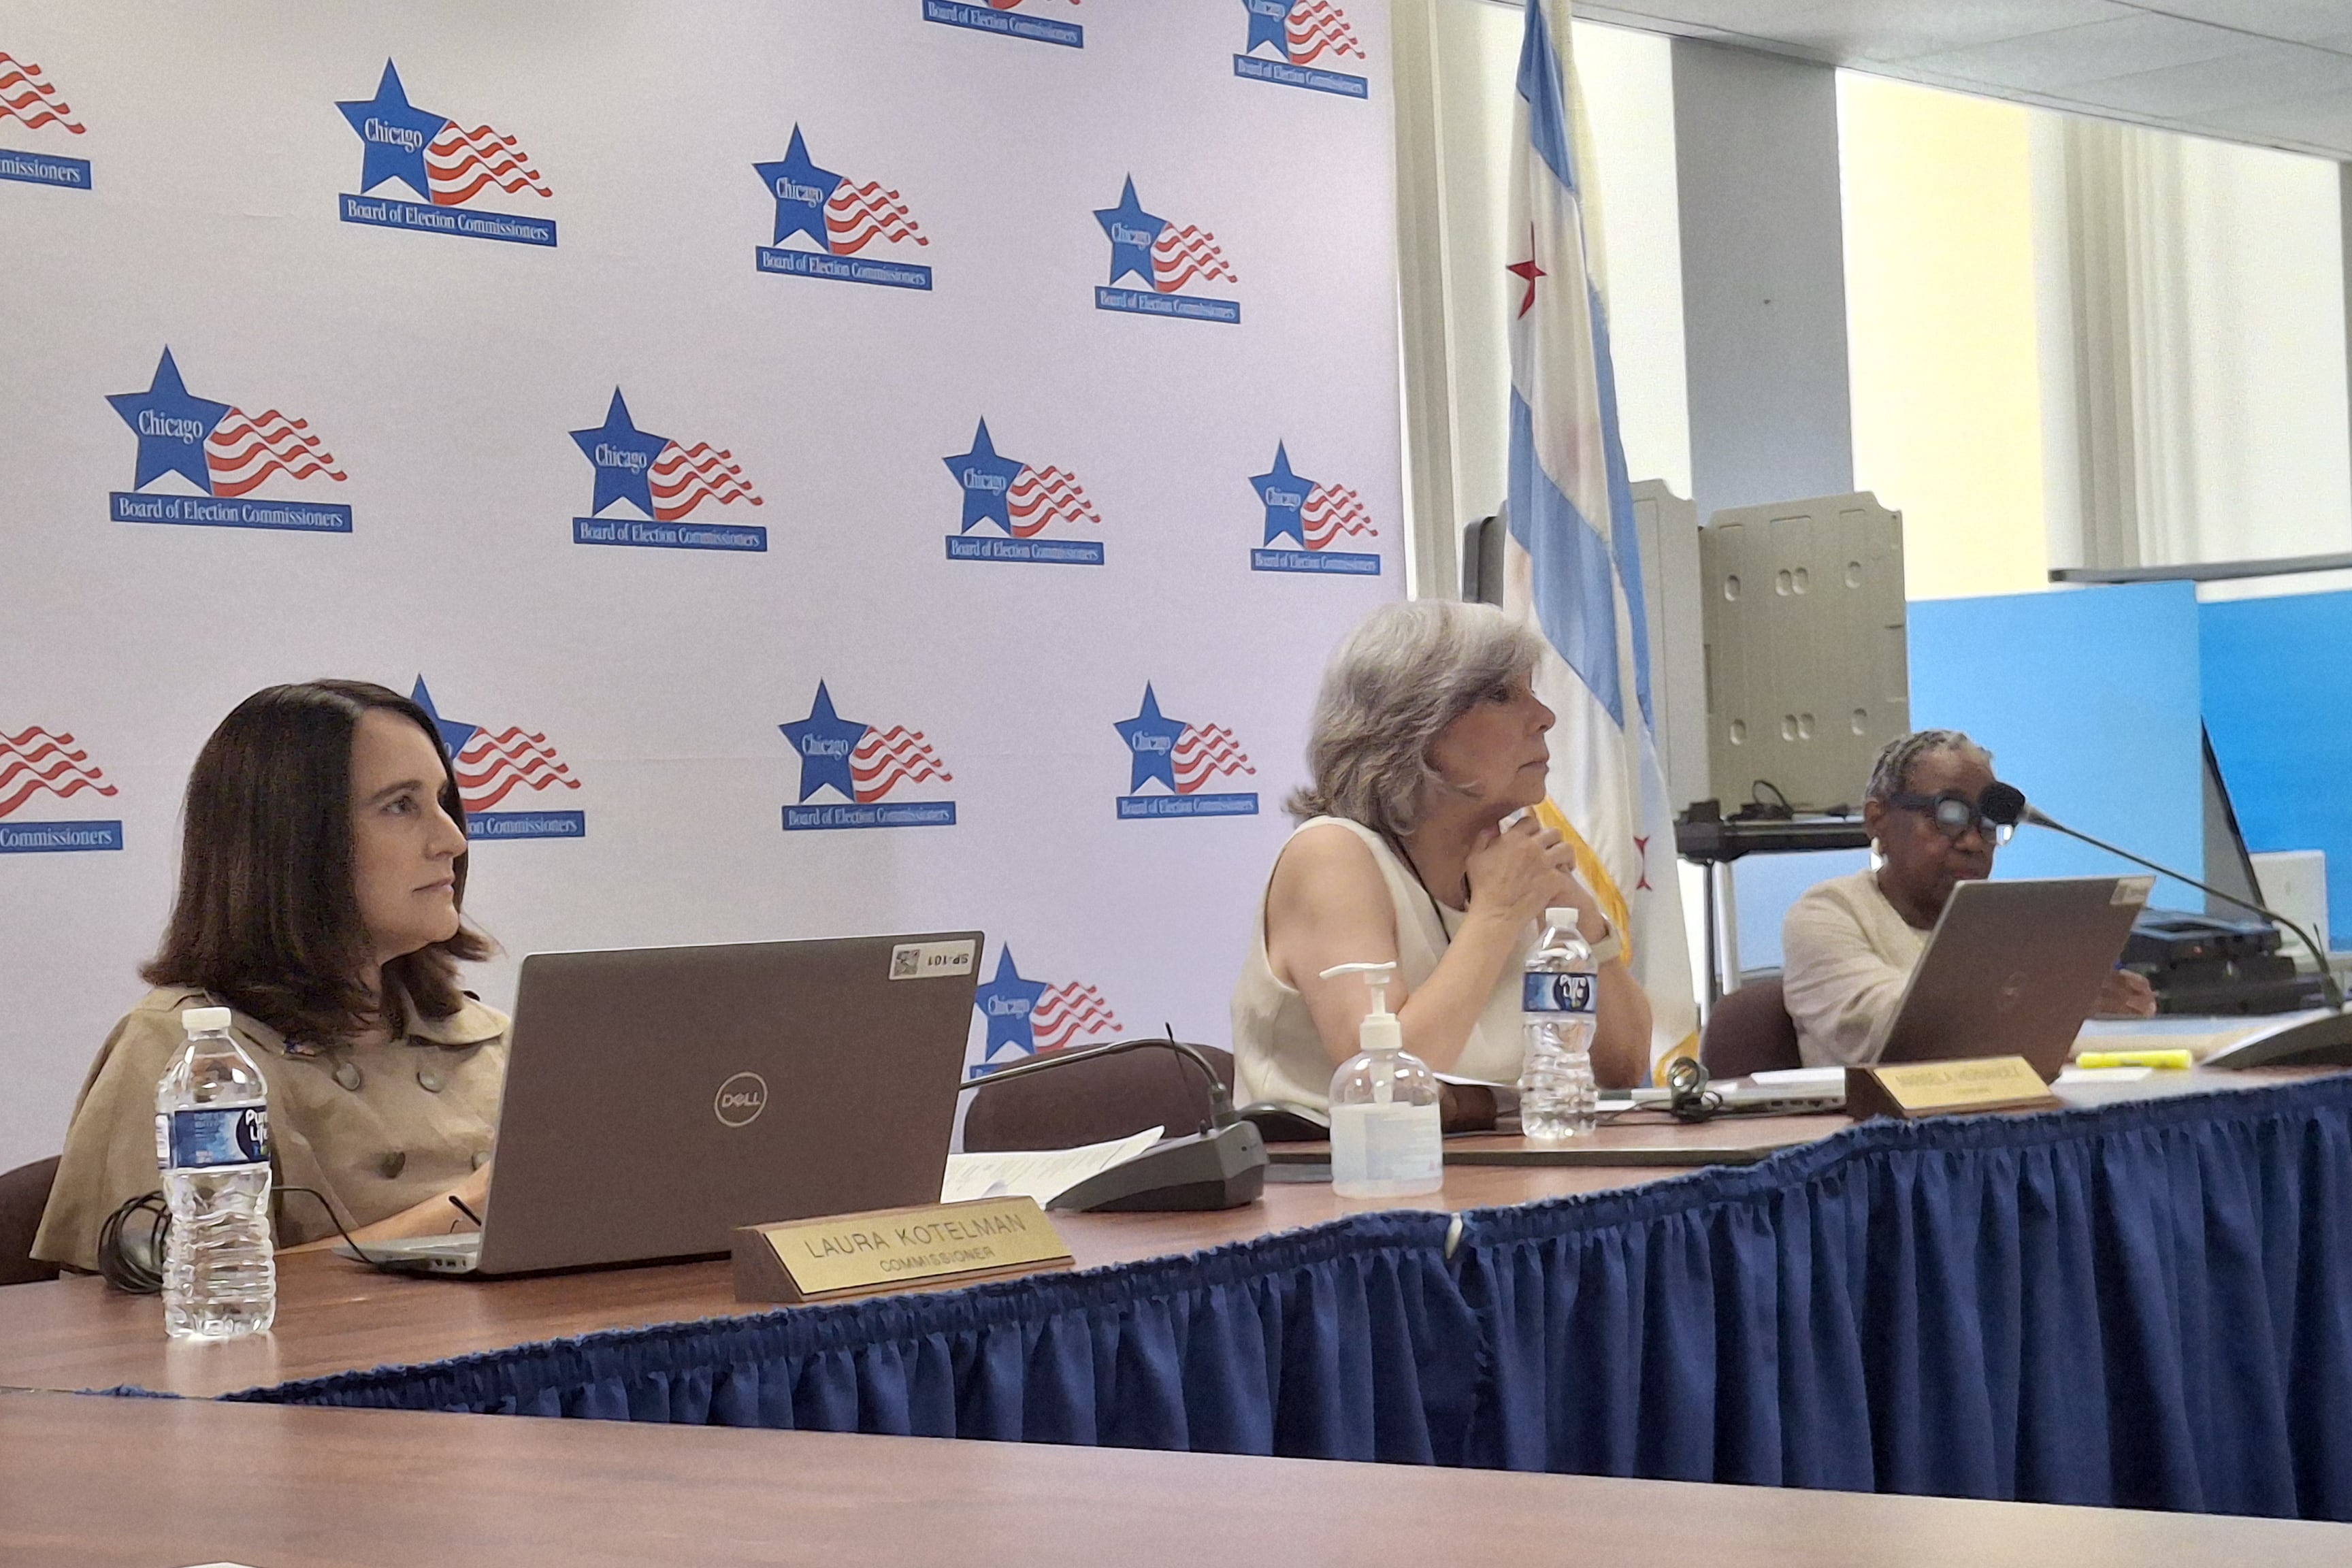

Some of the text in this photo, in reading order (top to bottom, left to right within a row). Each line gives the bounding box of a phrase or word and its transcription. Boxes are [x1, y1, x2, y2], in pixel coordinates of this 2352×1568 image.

[365, 118, 423, 153] Chicago
[776, 177, 823, 208] Chicago
[347, 199, 549, 241] Board of Election Commissioners
[762, 251, 794, 270] Board
[796, 254, 808, 272] of
[808, 257, 850, 276] Election
[139, 410, 203, 444] Chicago
[595, 443, 647, 474] Chicago
[119, 497, 343, 527] Board of Election Commissioners
[580, 522, 615, 540] Board
[617, 523, 630, 540] of
[632, 524, 676, 543] Election
[981, 541, 992, 557] of
[0, 827, 112, 847] Commissioners
[486, 817, 577, 834] Commissioners
[927, 953, 970, 966] SP-101
[721, 1092, 761, 1107] DELL
[804, 1213, 1027, 1259] LAURA KOTELMAN
[880, 1246, 996, 1273] COMMISSIONER
